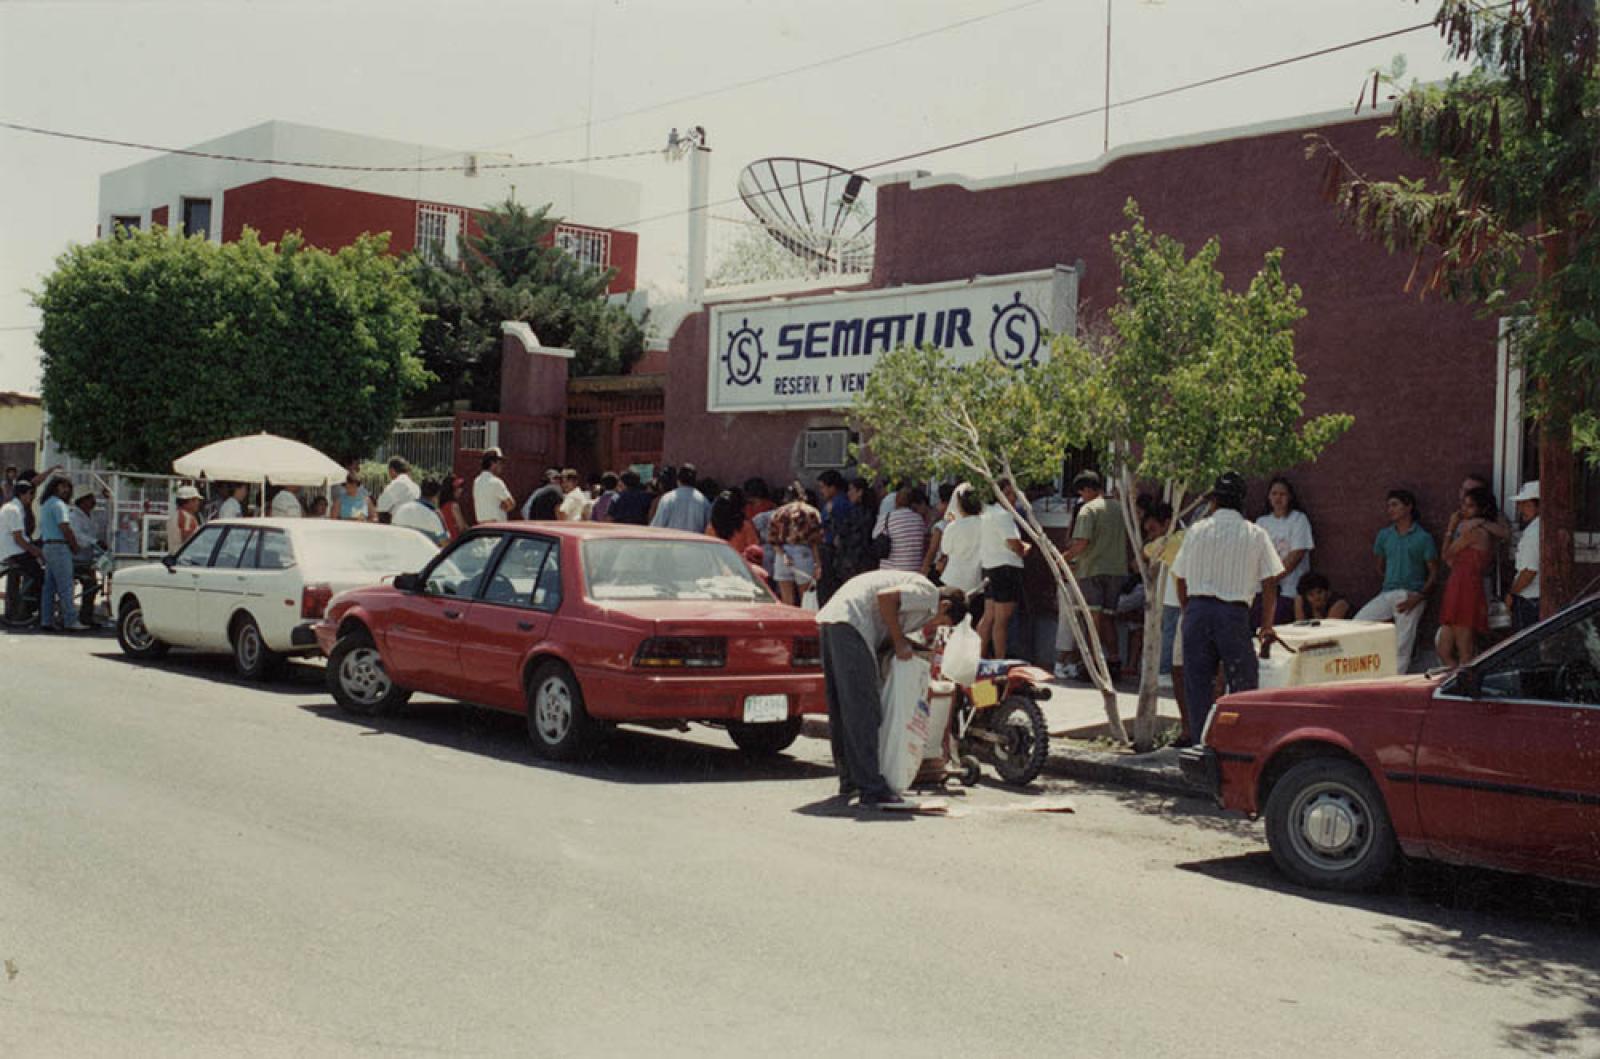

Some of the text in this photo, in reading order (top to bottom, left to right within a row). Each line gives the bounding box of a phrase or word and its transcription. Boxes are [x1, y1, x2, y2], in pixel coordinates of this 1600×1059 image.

[776, 307, 974, 361] SEMATUR
[1005, 314, 1026, 360] S
[737, 336, 752, 377] S
[774, 375, 820, 395] RESERV.
[826, 373, 833, 393] Y
[1335, 653, 1381, 675] TRIUNFO
